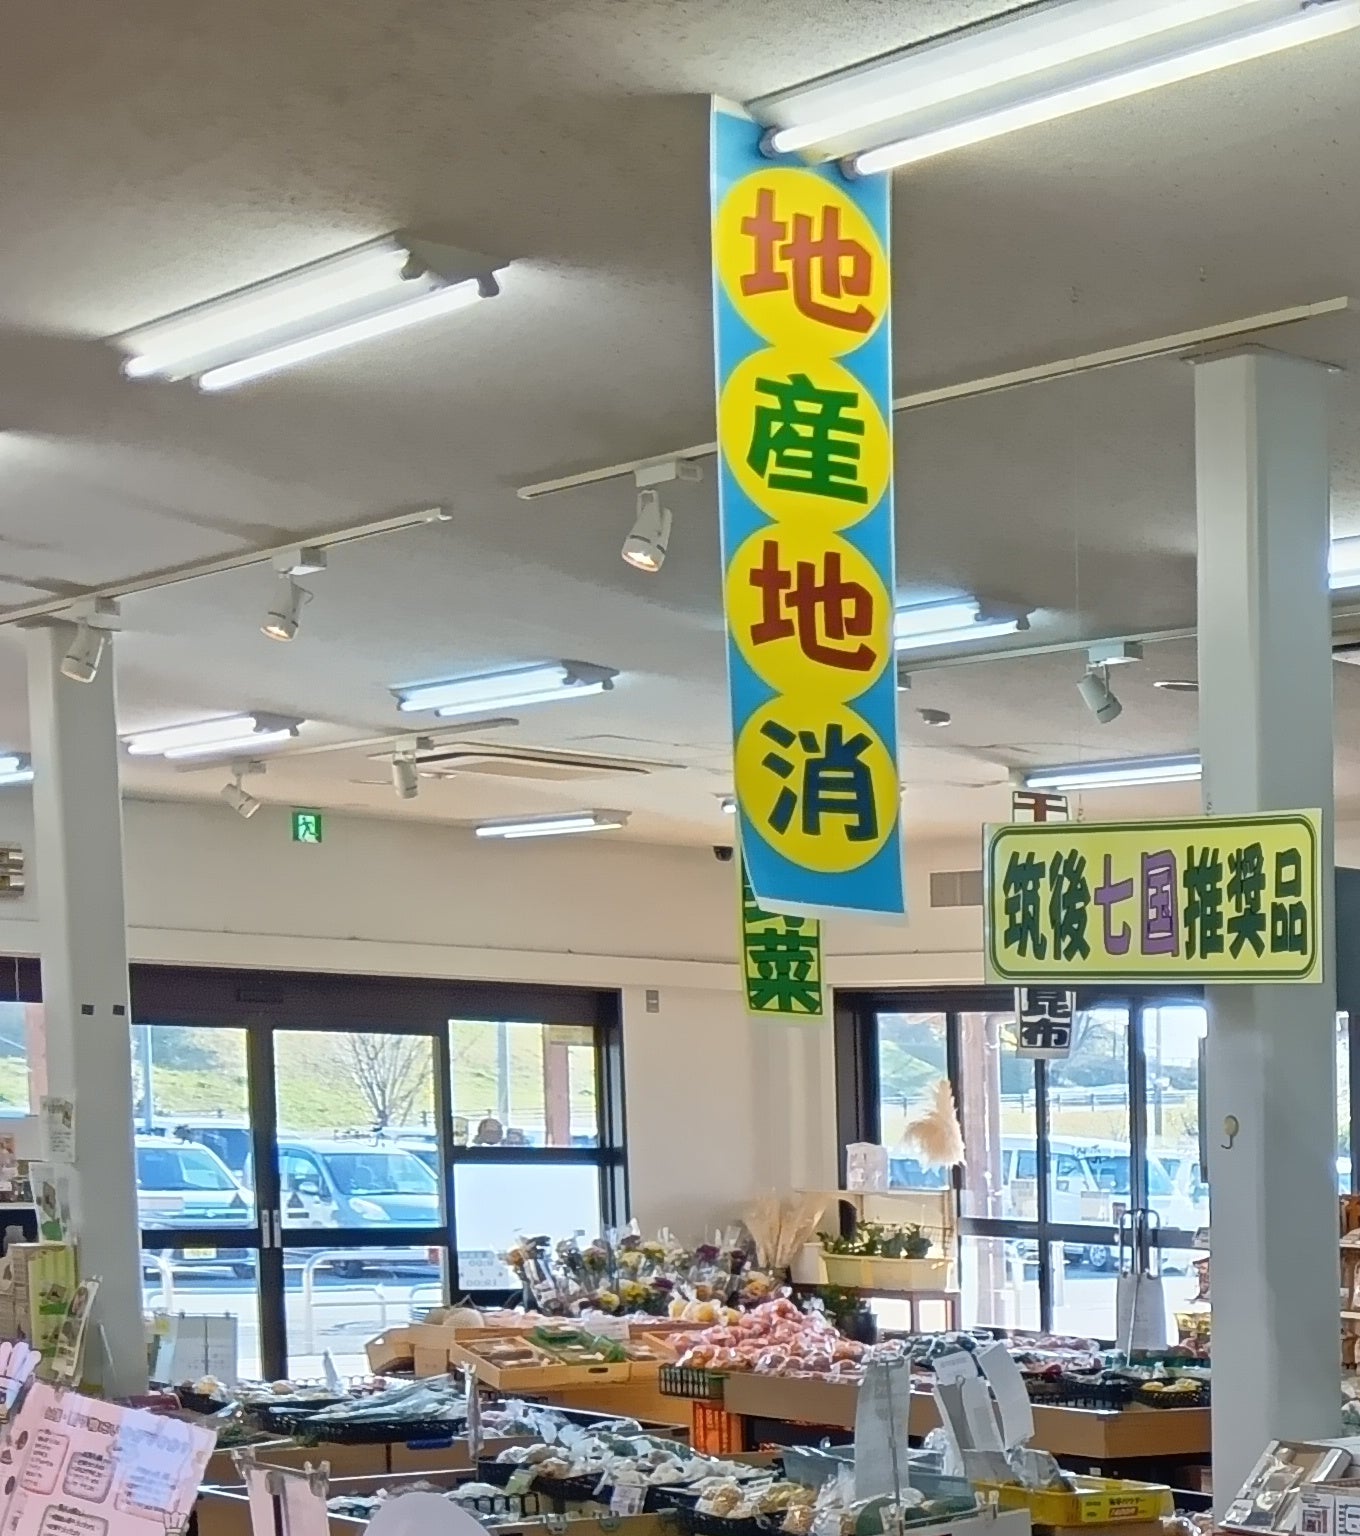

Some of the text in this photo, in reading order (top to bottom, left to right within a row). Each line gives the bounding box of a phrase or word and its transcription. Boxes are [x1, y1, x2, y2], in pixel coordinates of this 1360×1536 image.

[739, 187, 880, 844] 地産地消
[1003, 840, 1308, 963] 筑後七国推奨品
